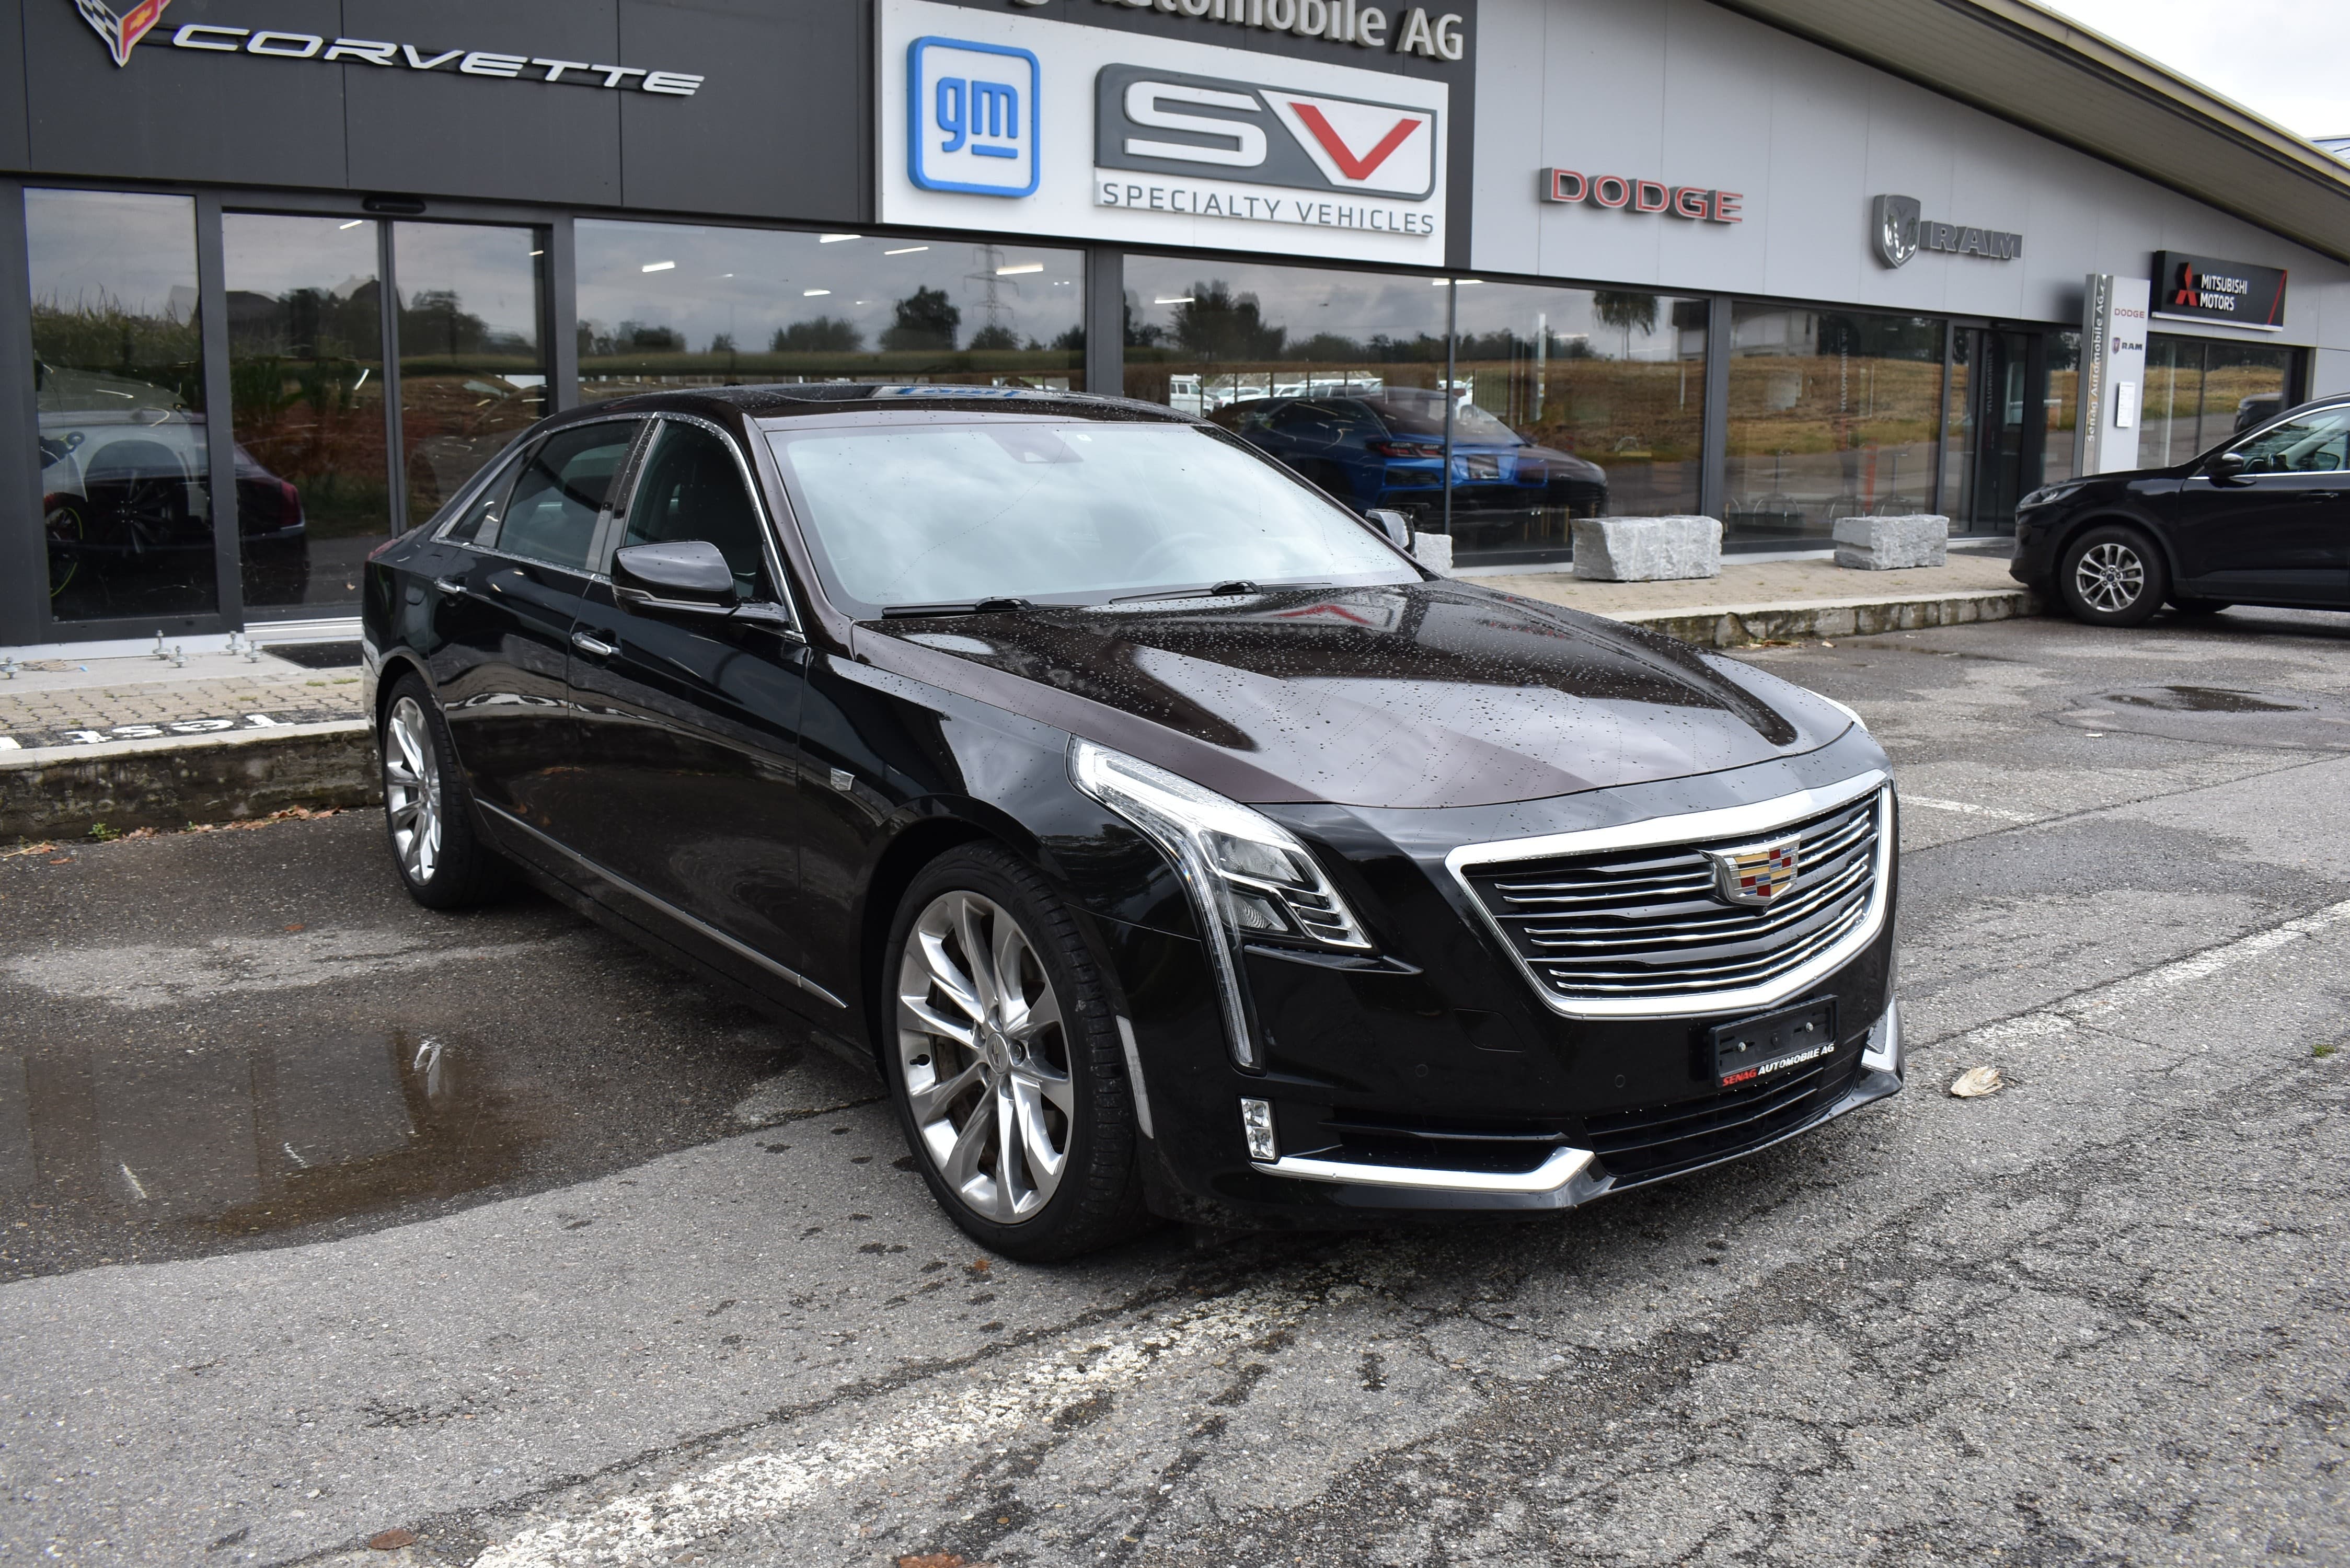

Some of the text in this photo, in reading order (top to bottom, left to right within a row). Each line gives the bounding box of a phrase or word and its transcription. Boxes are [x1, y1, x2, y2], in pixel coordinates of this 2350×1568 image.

[1098, 0, 1464, 61] mobile AG
[172, 24, 705, 96] CORVETTE
[937, 77, 1019, 154] gm
[1124, 80, 1424, 181] SV
[1103, 182, 1434, 236] SPECIALTY VEHICLES
[1541, 167, 1743, 223] DODGE
[1920, 220, 2022, 259] RAM
[2200, 292, 2234, 311] MOTORS
[2201, 274, 2248, 295] MITSUBISHI
[2114, 308, 2145, 319] DODGE
[2090, 318, 2103, 397] Automobile
[2097, 295, 2104, 314] AG
[2122, 342, 2143, 351] RAM
[64, 714, 295, 744] Test
[1722, 1043, 1835, 1087] SENAG AUTOMOBILE AG
